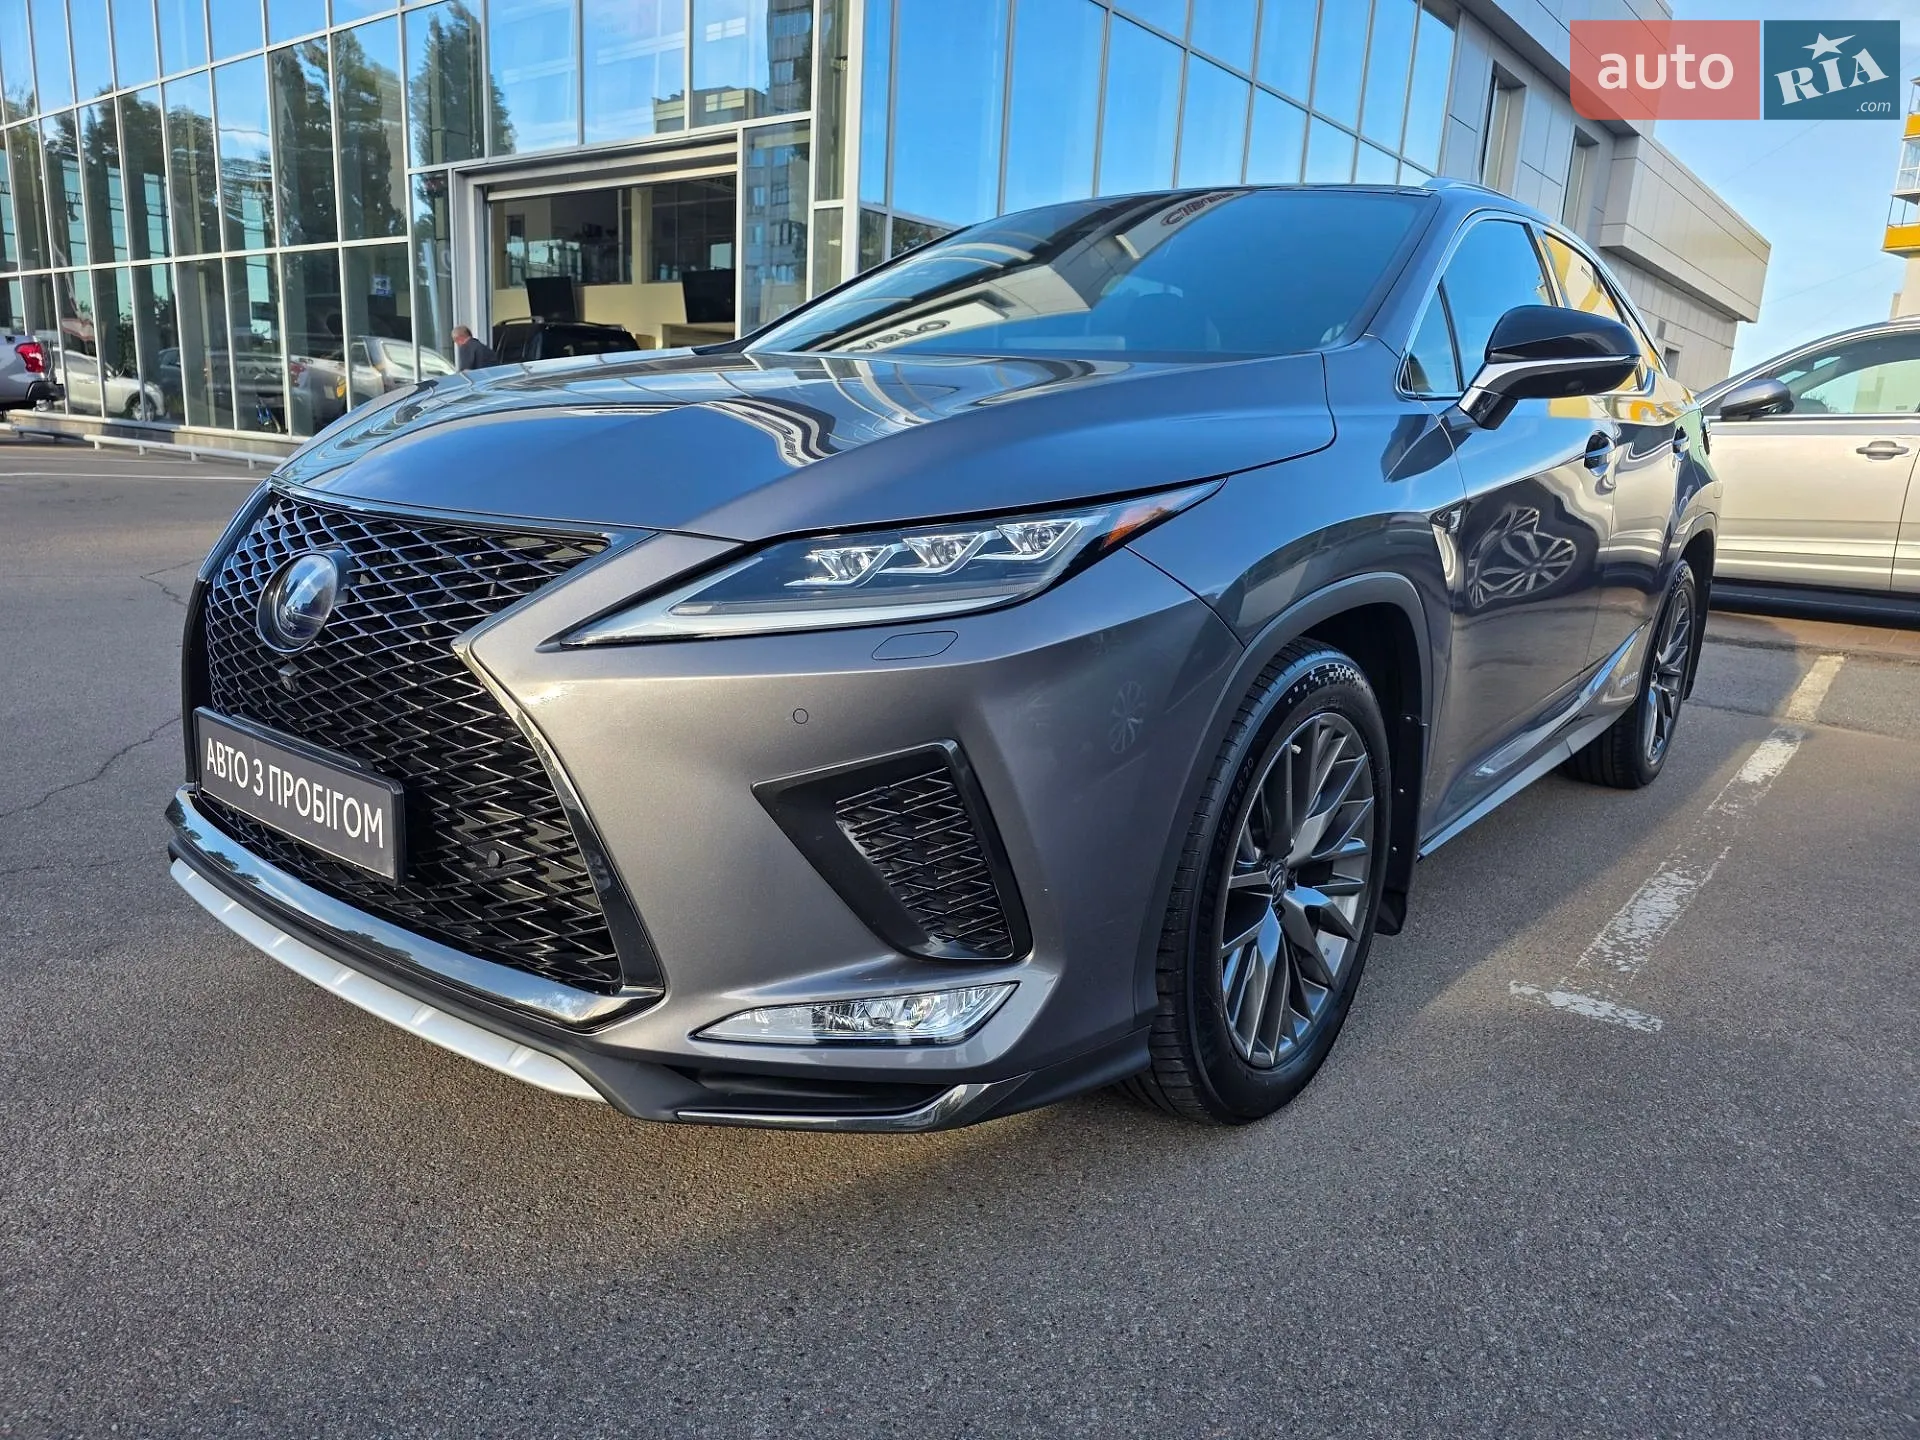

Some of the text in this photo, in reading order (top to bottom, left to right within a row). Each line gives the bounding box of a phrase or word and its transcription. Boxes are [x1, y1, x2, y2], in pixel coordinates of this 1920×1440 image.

[206, 737, 384, 849] АВТО З ПРОБІГОМ
